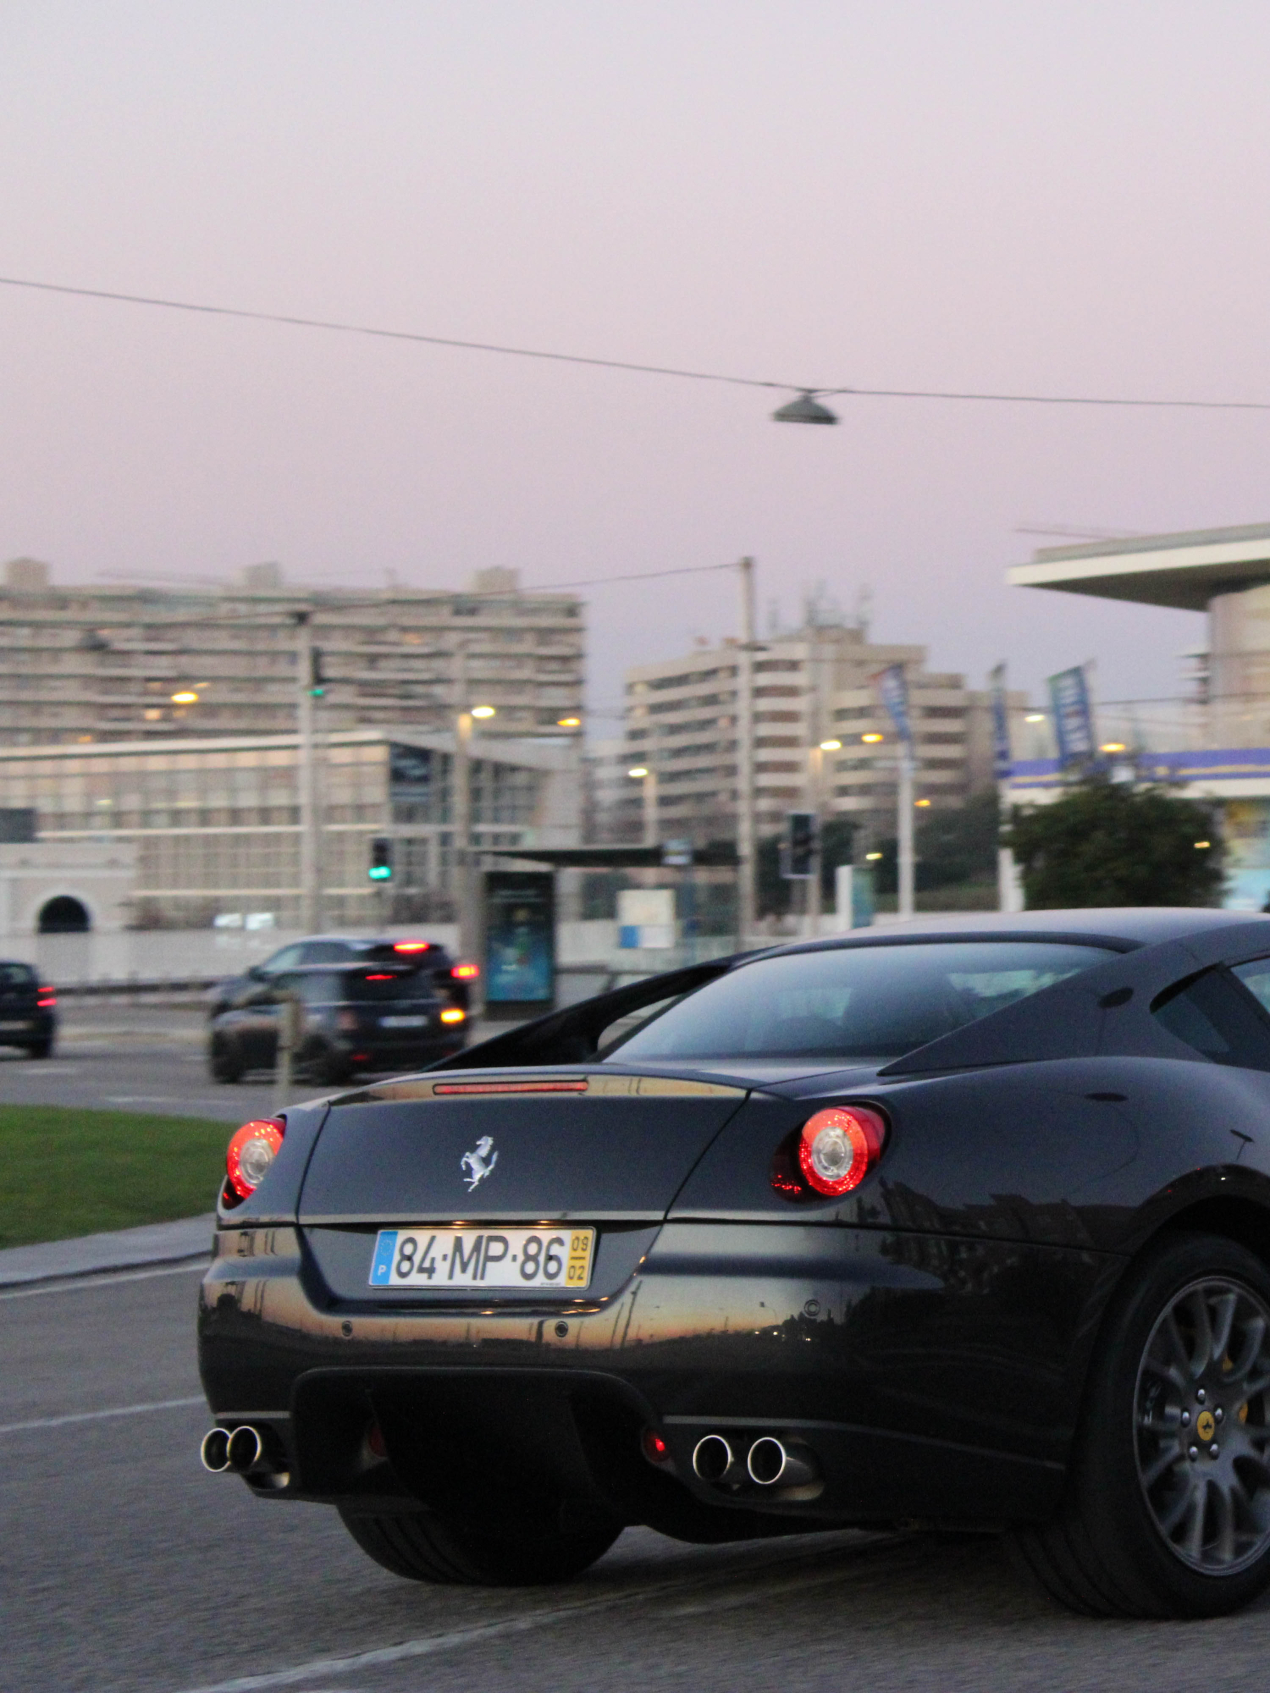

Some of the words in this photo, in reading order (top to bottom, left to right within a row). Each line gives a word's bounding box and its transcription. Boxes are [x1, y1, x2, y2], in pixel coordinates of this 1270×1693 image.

[572, 1236, 589, 1252] 09
[377, 1264, 387, 1276] P
[568, 1264, 584, 1280] 02
